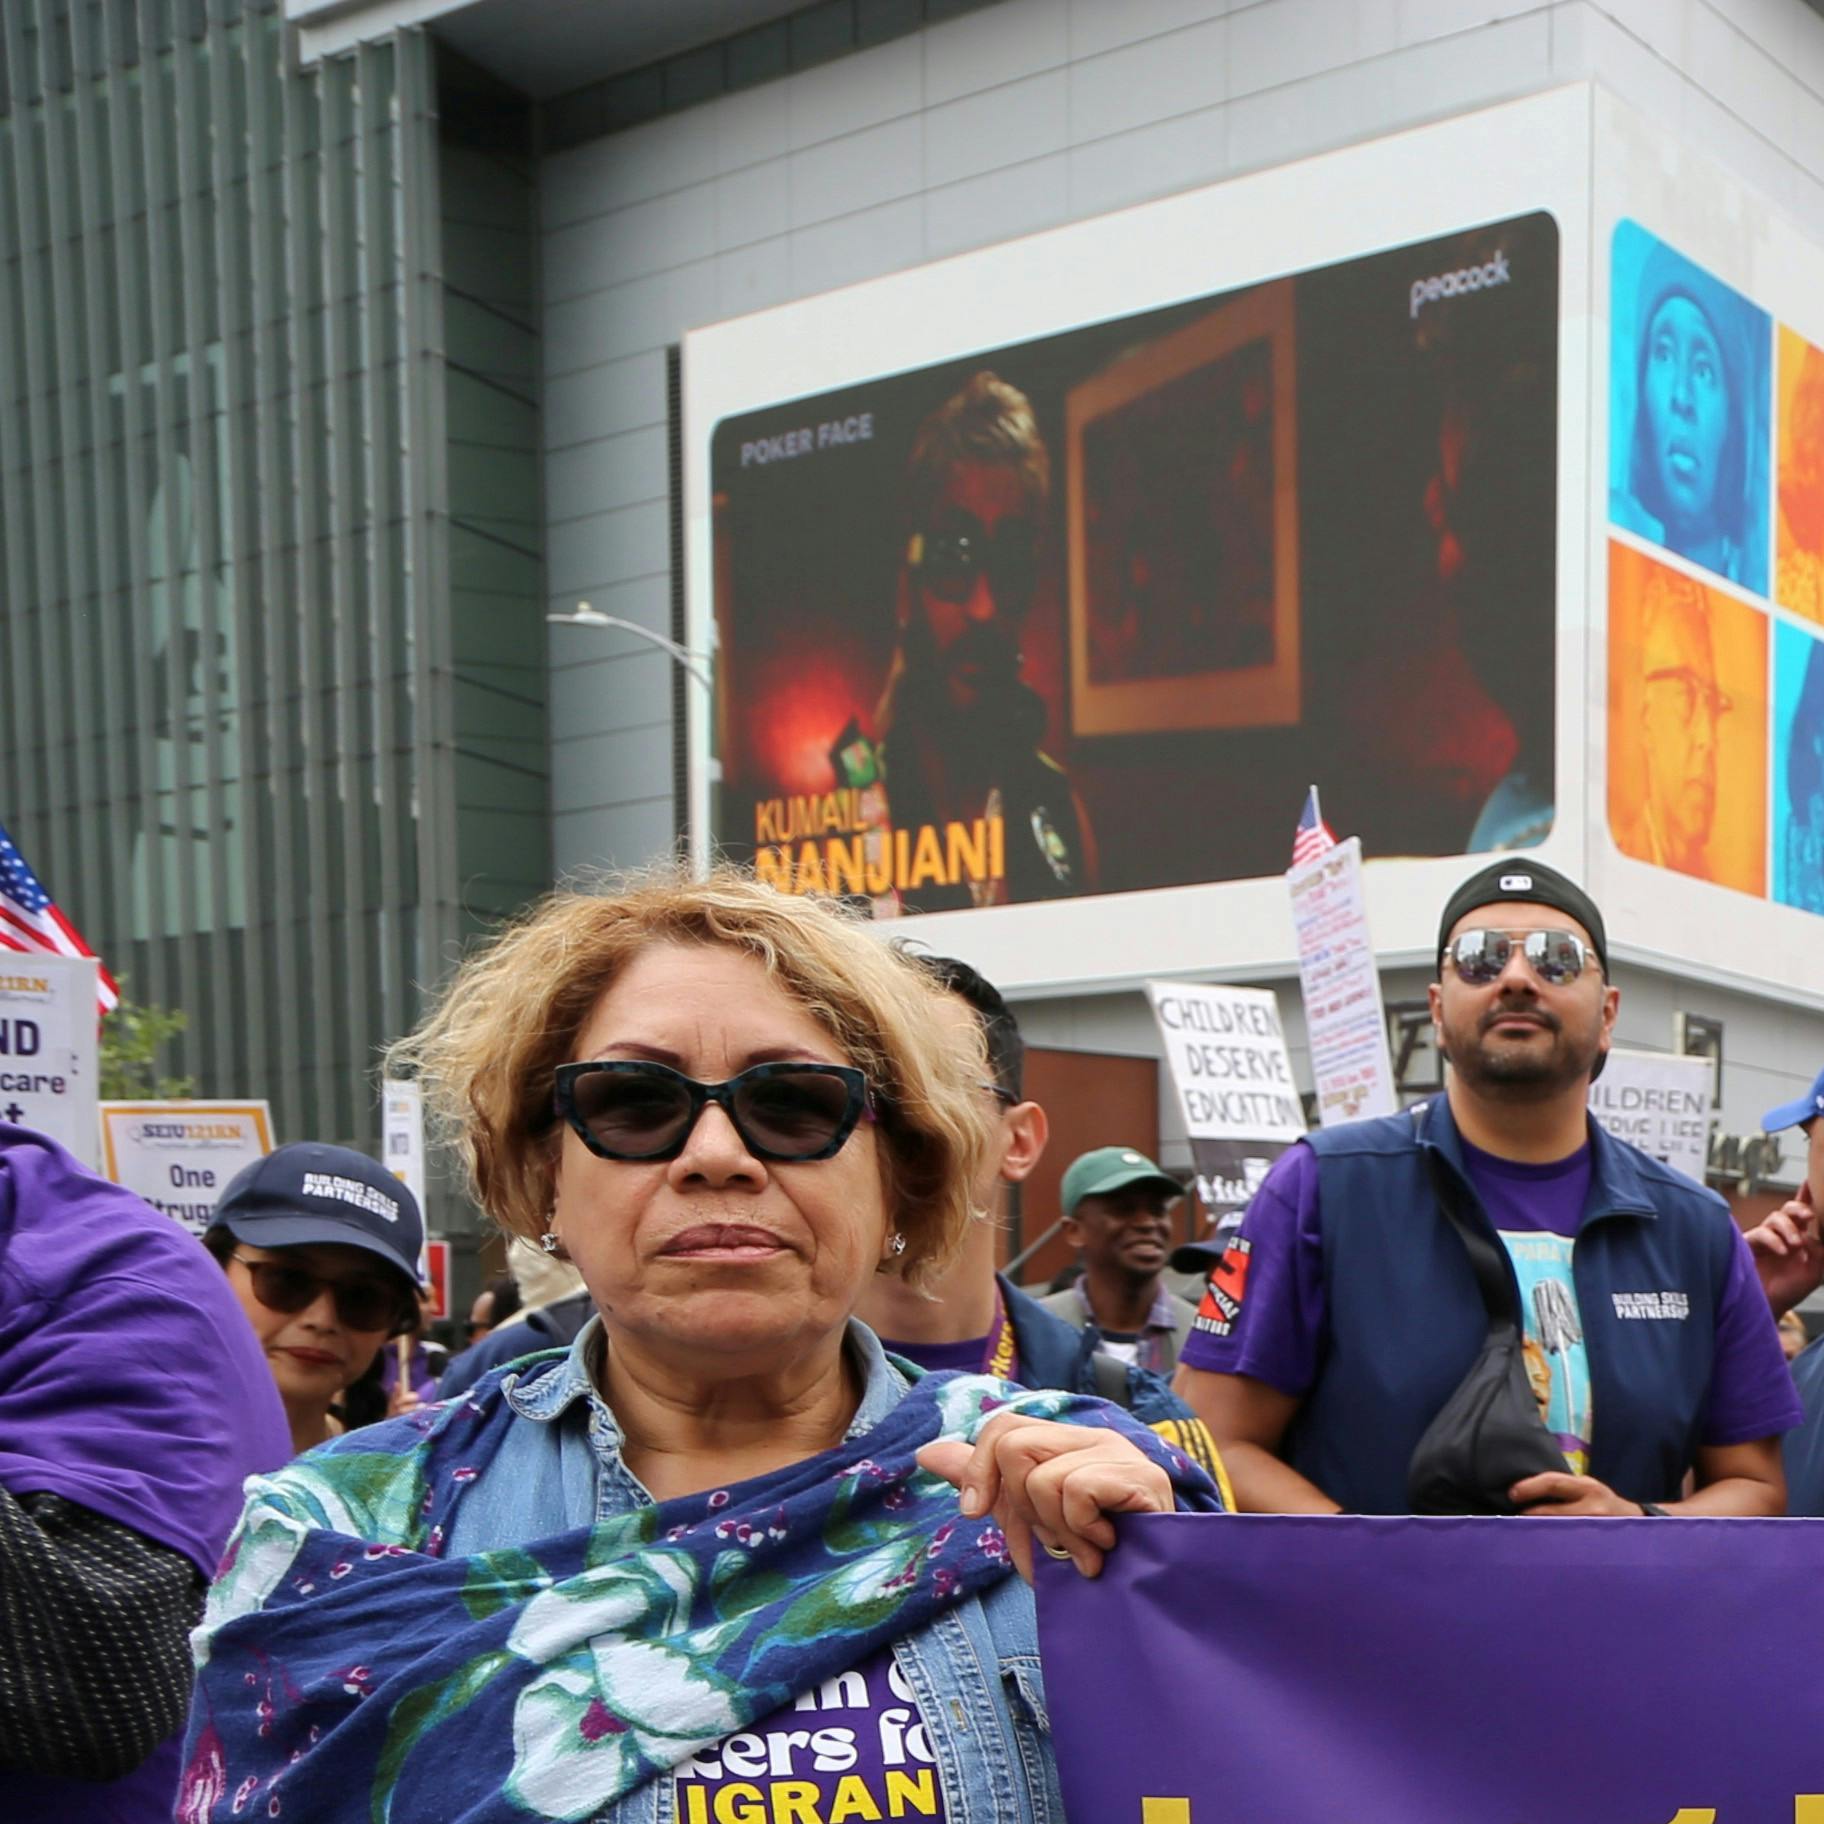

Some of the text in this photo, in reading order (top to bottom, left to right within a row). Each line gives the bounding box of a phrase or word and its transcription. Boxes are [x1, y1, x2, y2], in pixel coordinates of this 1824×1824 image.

[1410, 250, 1510, 318] peacock
[741, 412, 873, 467] POKER FACE
[756, 788, 868, 843] KUMAIL
[755, 816, 1004, 895] NANJIANI
[1160, 996, 1279, 1037] CHILDREN
[1186, 1044, 1291, 1083] DESERVE
[1594, 1086, 1704, 1114] ILDREN
[170, 1164, 215, 1188] One
[302, 1183, 399, 1224] PARTNERSHIP
[1612, 1292, 1659, 1306] BUILDING
[1615, 1305, 1690, 1320] PARTNERSHIP
